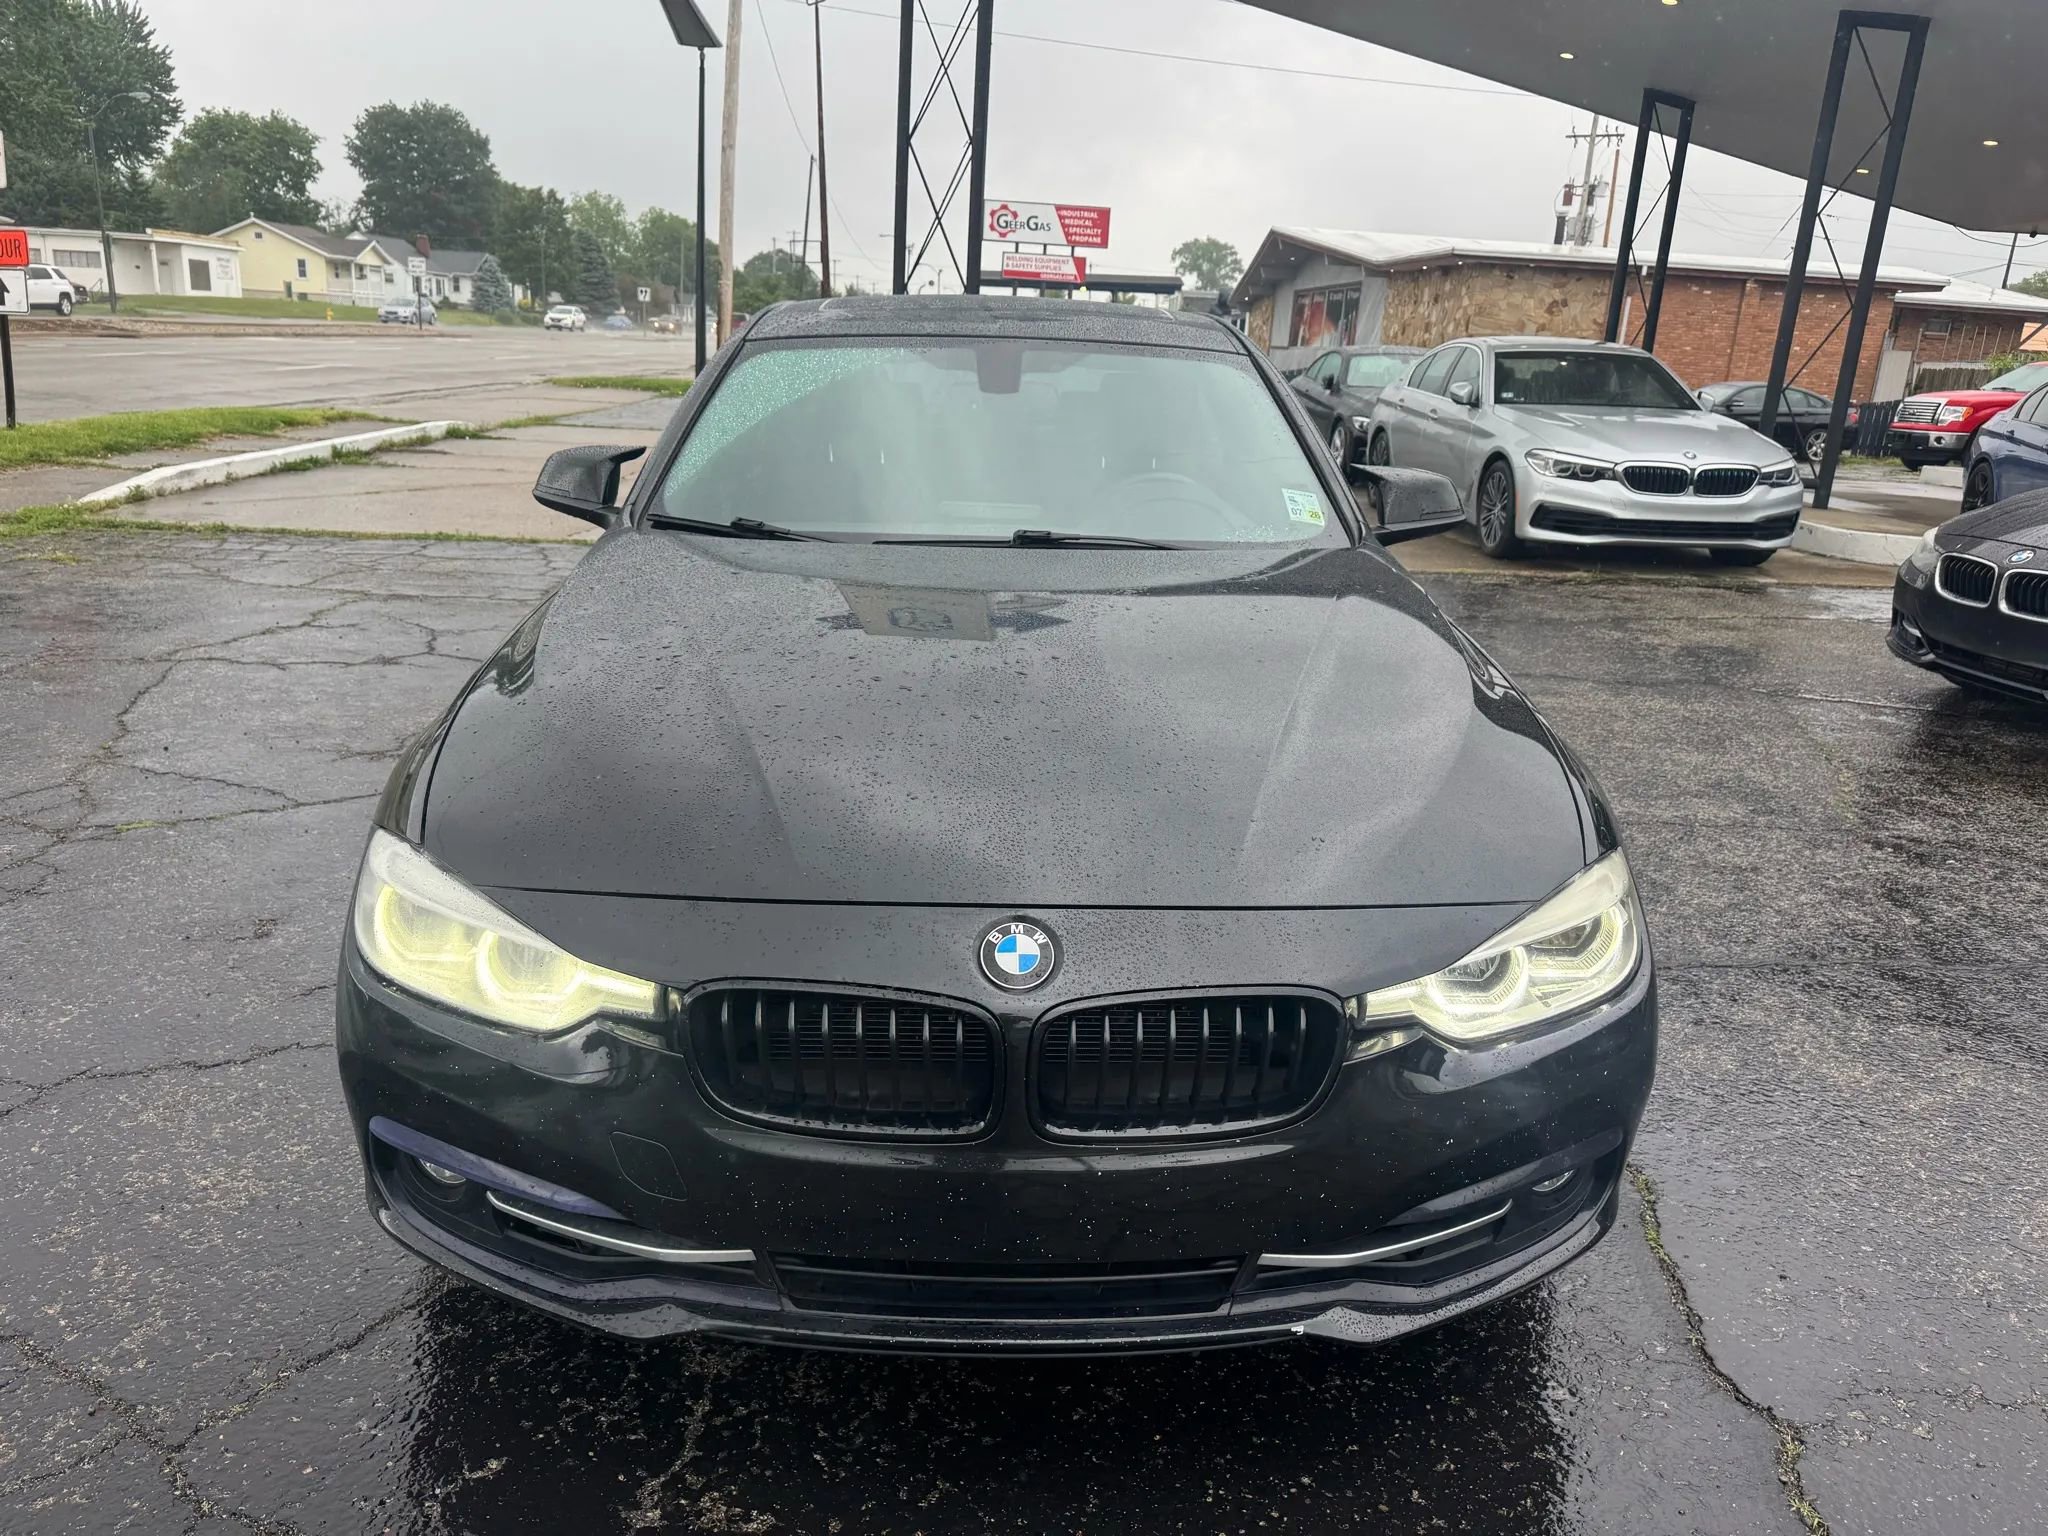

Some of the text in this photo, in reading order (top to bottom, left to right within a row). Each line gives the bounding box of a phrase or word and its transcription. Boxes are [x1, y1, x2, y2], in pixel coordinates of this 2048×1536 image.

[1060, 211, 1098, 219] INDUSTRIAL
[1069, 227, 1102, 235] SPECIALTY
[1006, 255, 1070, 265] WELDING EQUIPMENT
[988, 924, 1048, 945] BMW
